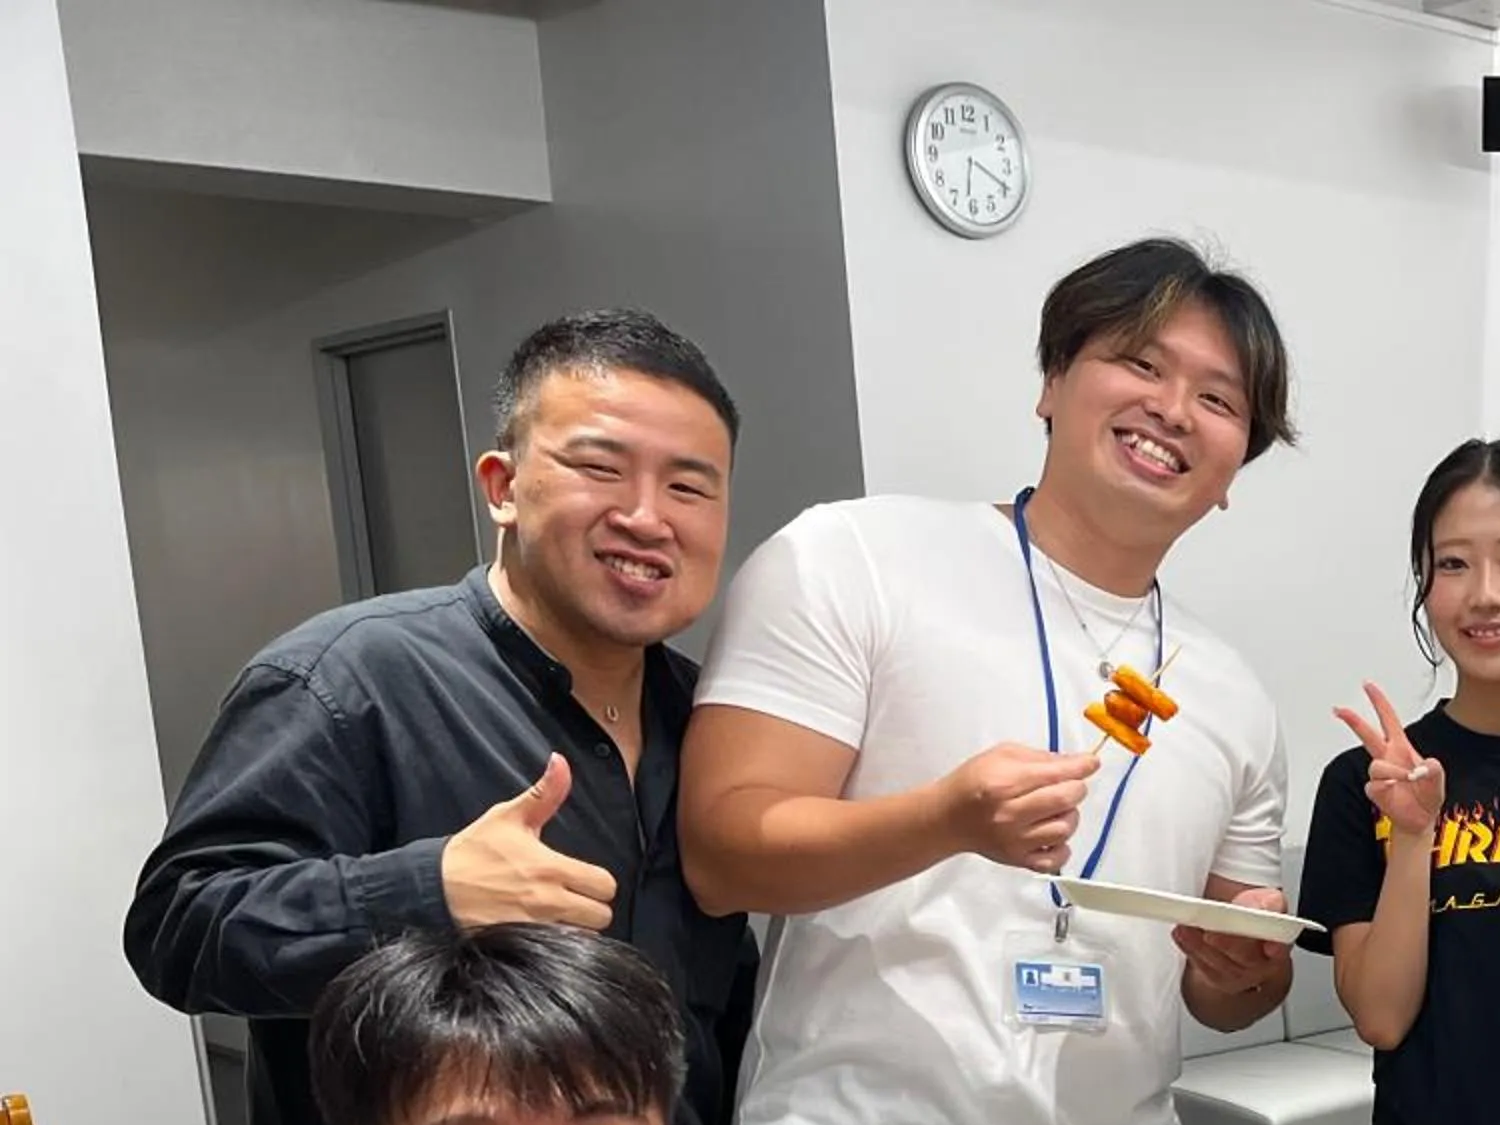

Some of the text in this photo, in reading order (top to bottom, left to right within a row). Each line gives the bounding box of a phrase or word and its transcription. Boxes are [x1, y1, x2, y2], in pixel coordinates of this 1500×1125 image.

[944, 107, 955, 126] 11
[960, 104, 975, 123] 12
[931, 122, 945, 141] 10
[995, 135, 1005, 151] 2
[928, 145, 938, 162] 9
[1002, 158, 1011, 175] 3
[935, 170, 945, 187] 8
[950, 189, 959, 206] 7
[986, 194, 996, 212] 5
[968, 198, 979, 215] 6
